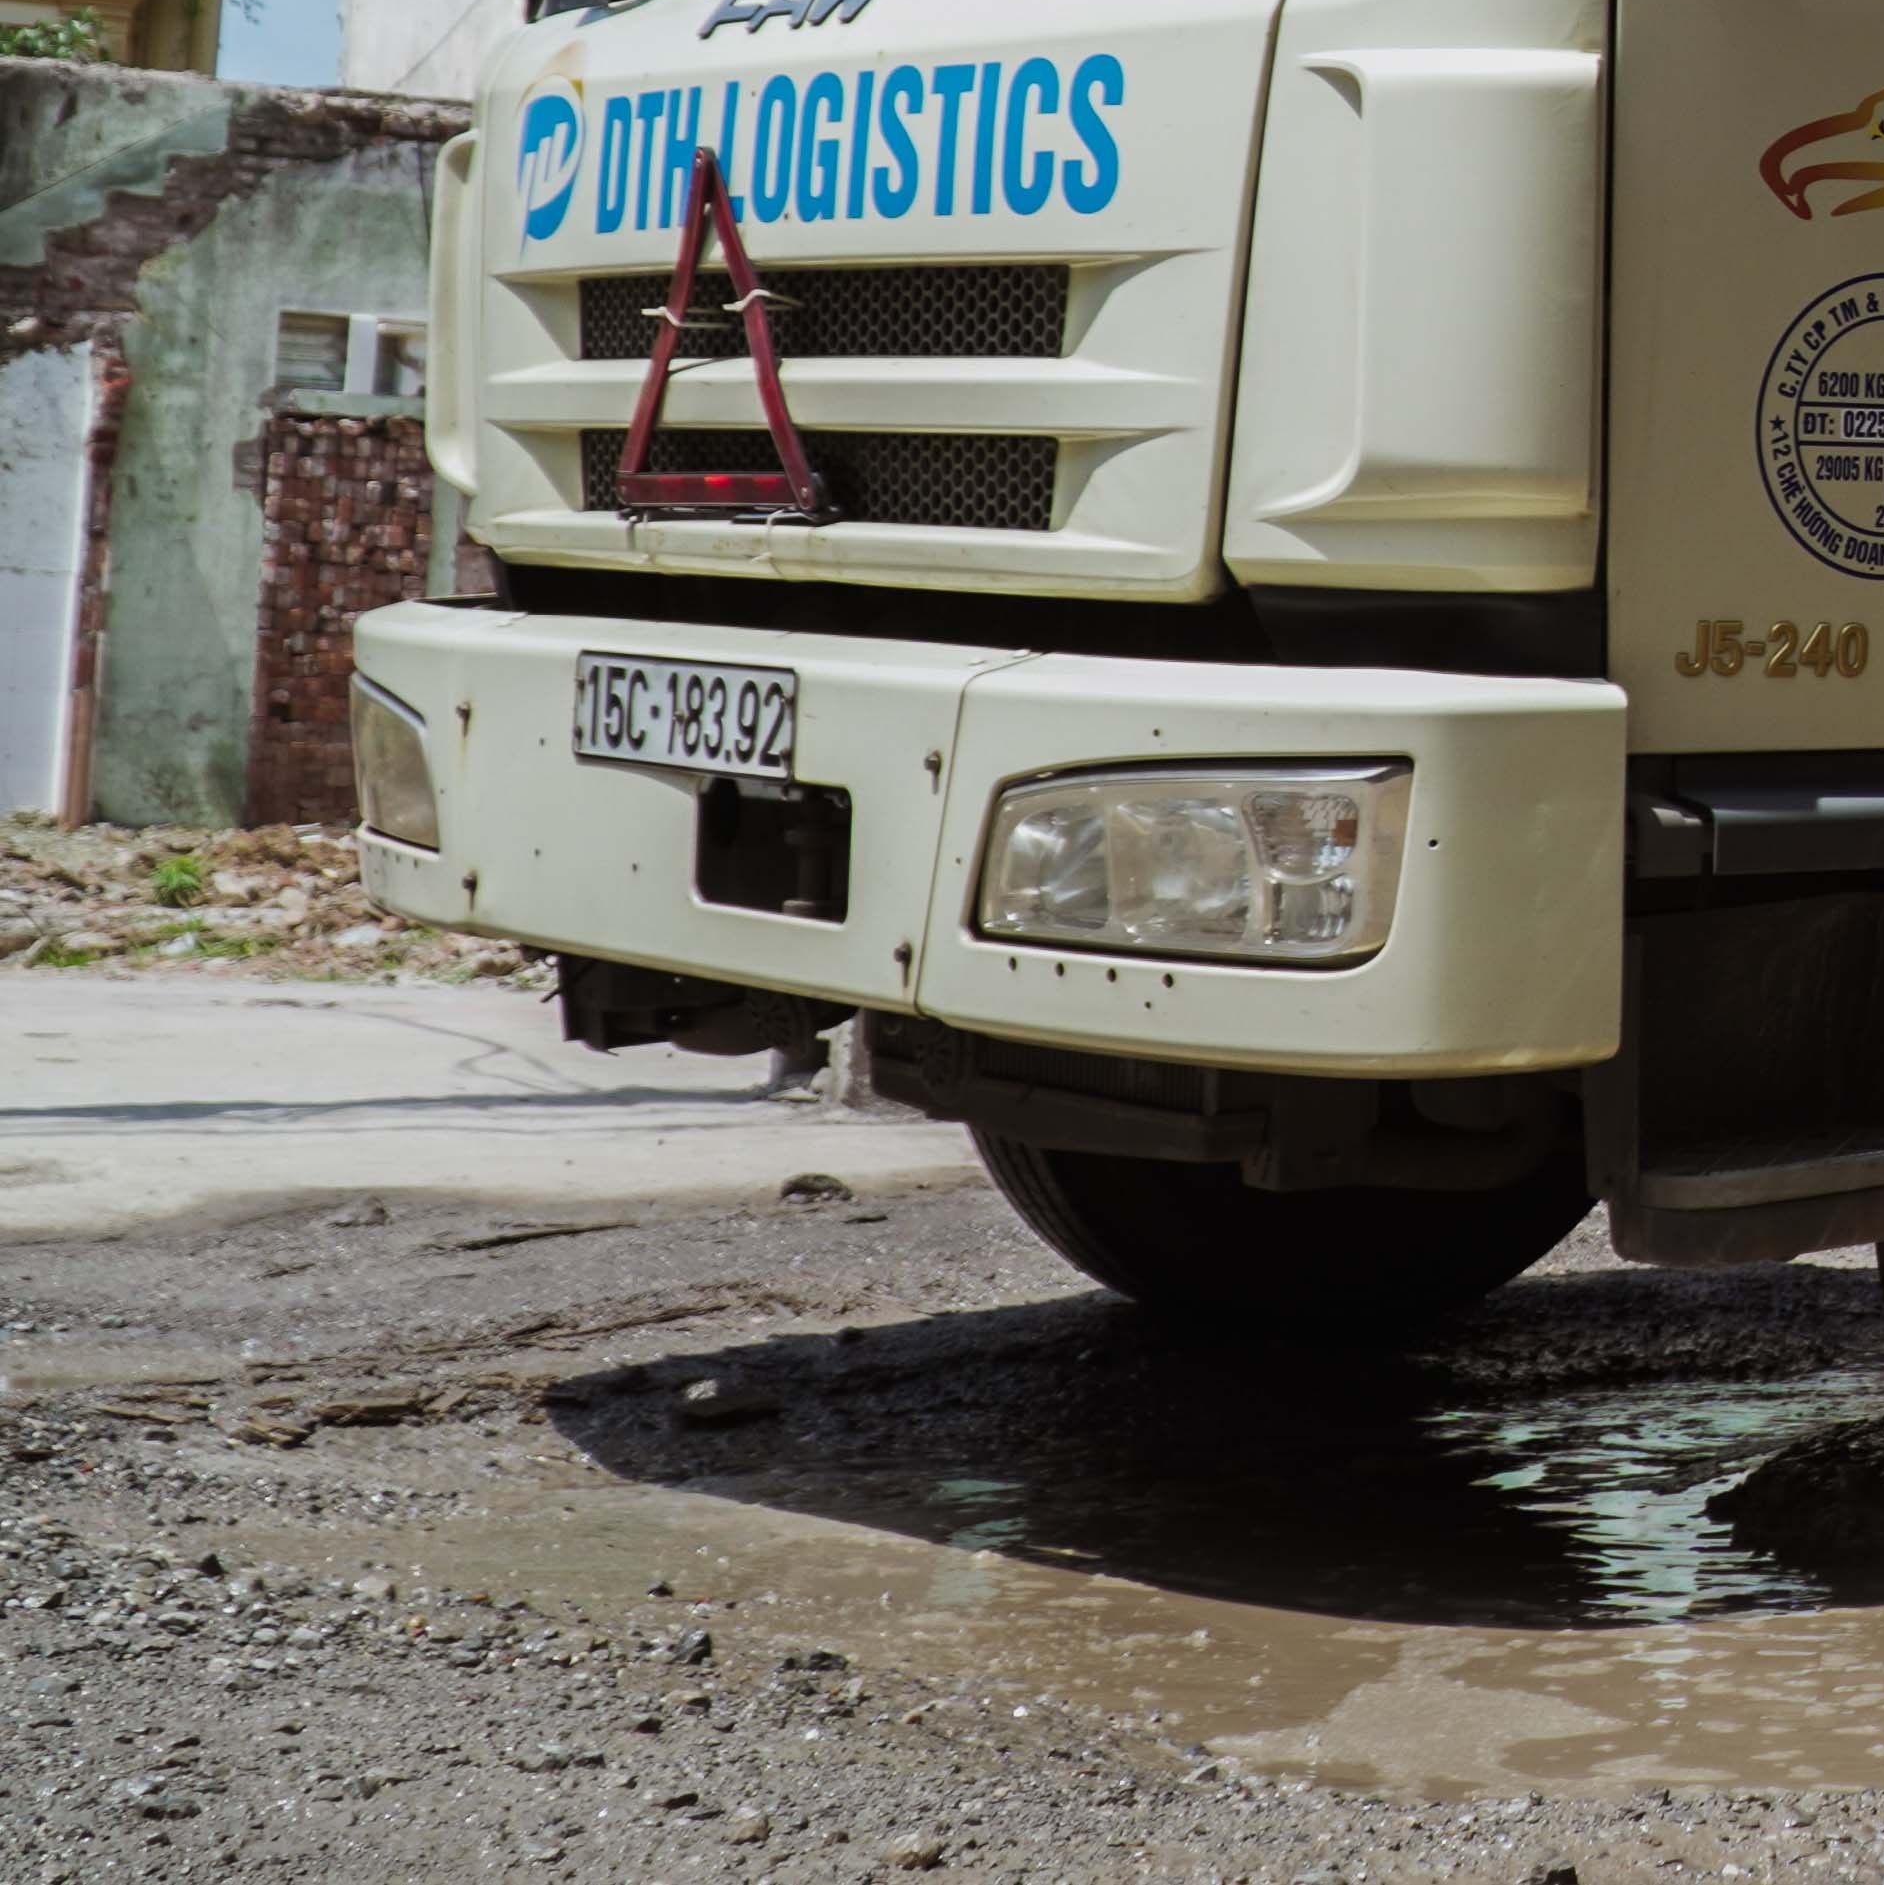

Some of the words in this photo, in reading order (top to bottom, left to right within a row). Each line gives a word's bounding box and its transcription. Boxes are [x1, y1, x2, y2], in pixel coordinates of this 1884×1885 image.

[595, 85, 703, 235] DTH
[718, 53, 1125, 223] LOGISTICS
[1778, 346, 1809, 399] C.TY
[1802, 319, 1828, 349] CP
[1828, 298, 1861, 328] TM
[1866, 292, 1879, 313] &
[1818, 371, 1859, 398] 6200
[1770, 430, 1791, 461] 12
[1803, 412, 1835, 435] ĐT:
[1816, 455, 1860, 482] 29005
[1864, 456, 1884, 483] KG
[1674, 619, 1869, 678] J5-240
[588, 665, 785, 767] 15C-183.92
